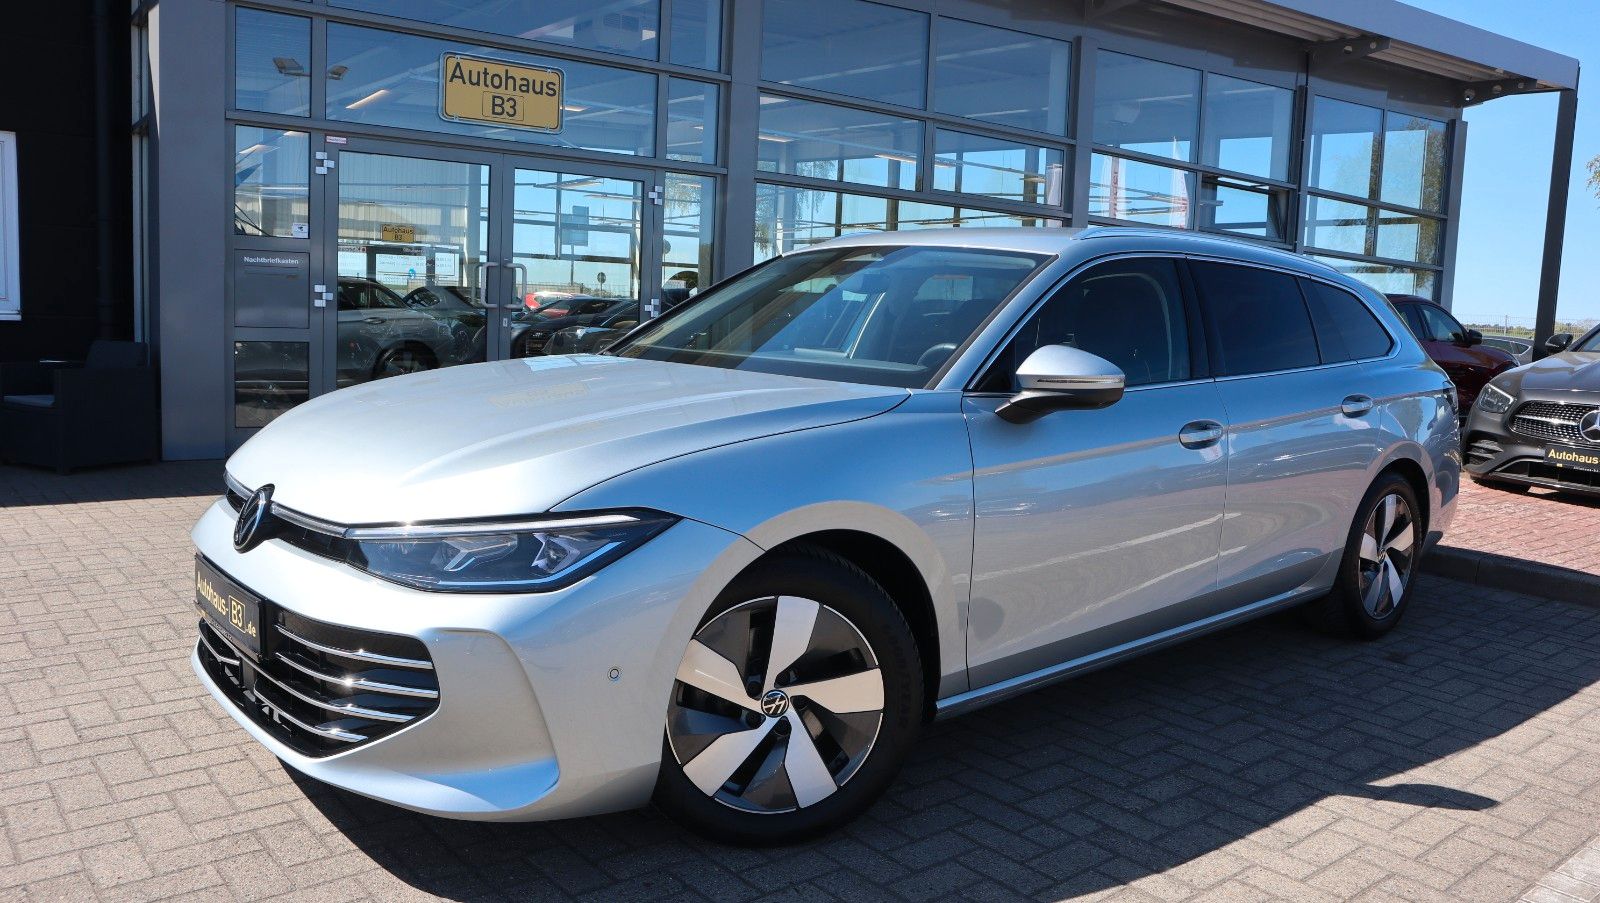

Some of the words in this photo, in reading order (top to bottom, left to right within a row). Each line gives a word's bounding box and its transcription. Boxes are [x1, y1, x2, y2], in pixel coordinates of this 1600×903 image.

[449, 62, 557, 97] Autohaus
[491, 95, 517, 117] B3
[243, 256, 299, 265] Nachtbriefkasten
